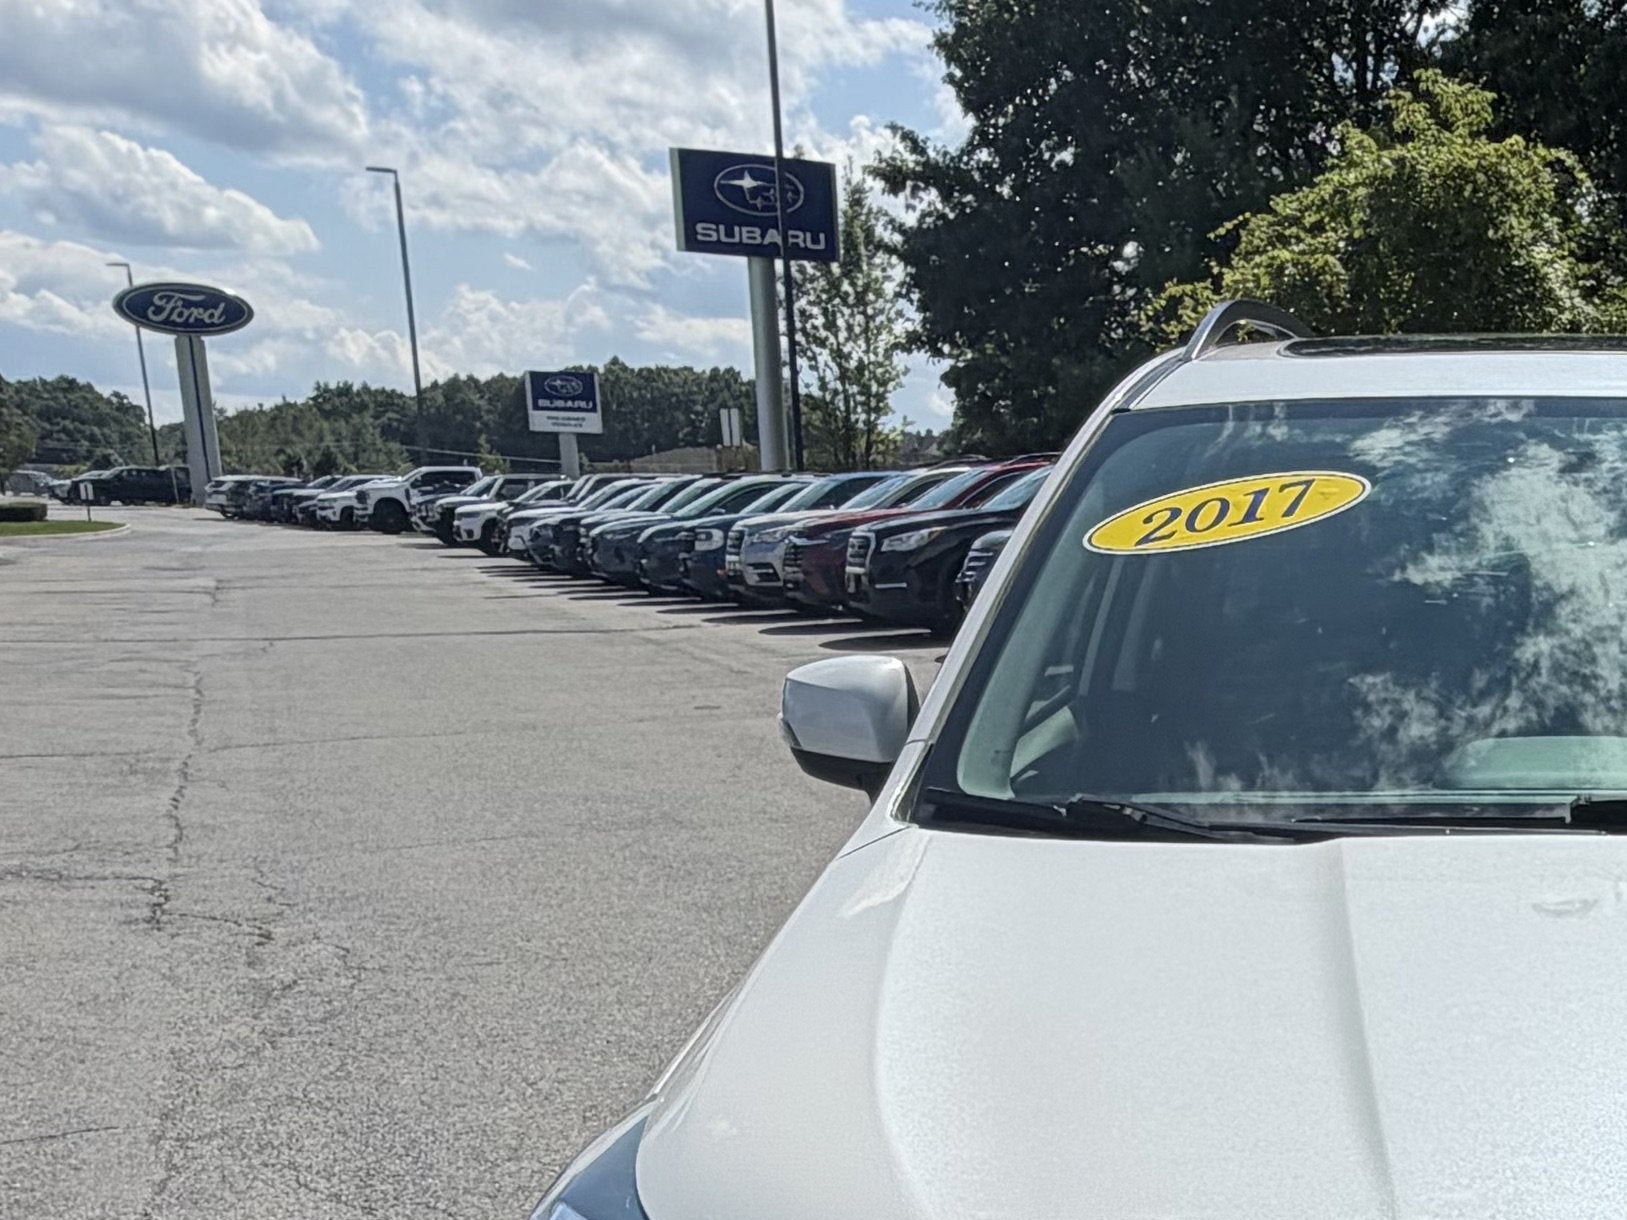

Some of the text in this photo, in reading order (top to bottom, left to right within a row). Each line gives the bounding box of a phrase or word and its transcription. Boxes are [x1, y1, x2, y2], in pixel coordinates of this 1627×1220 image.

[695, 222, 826, 250] SUBARU
[147, 291, 226, 324] Ford
[1134, 478, 1316, 547] 2017
